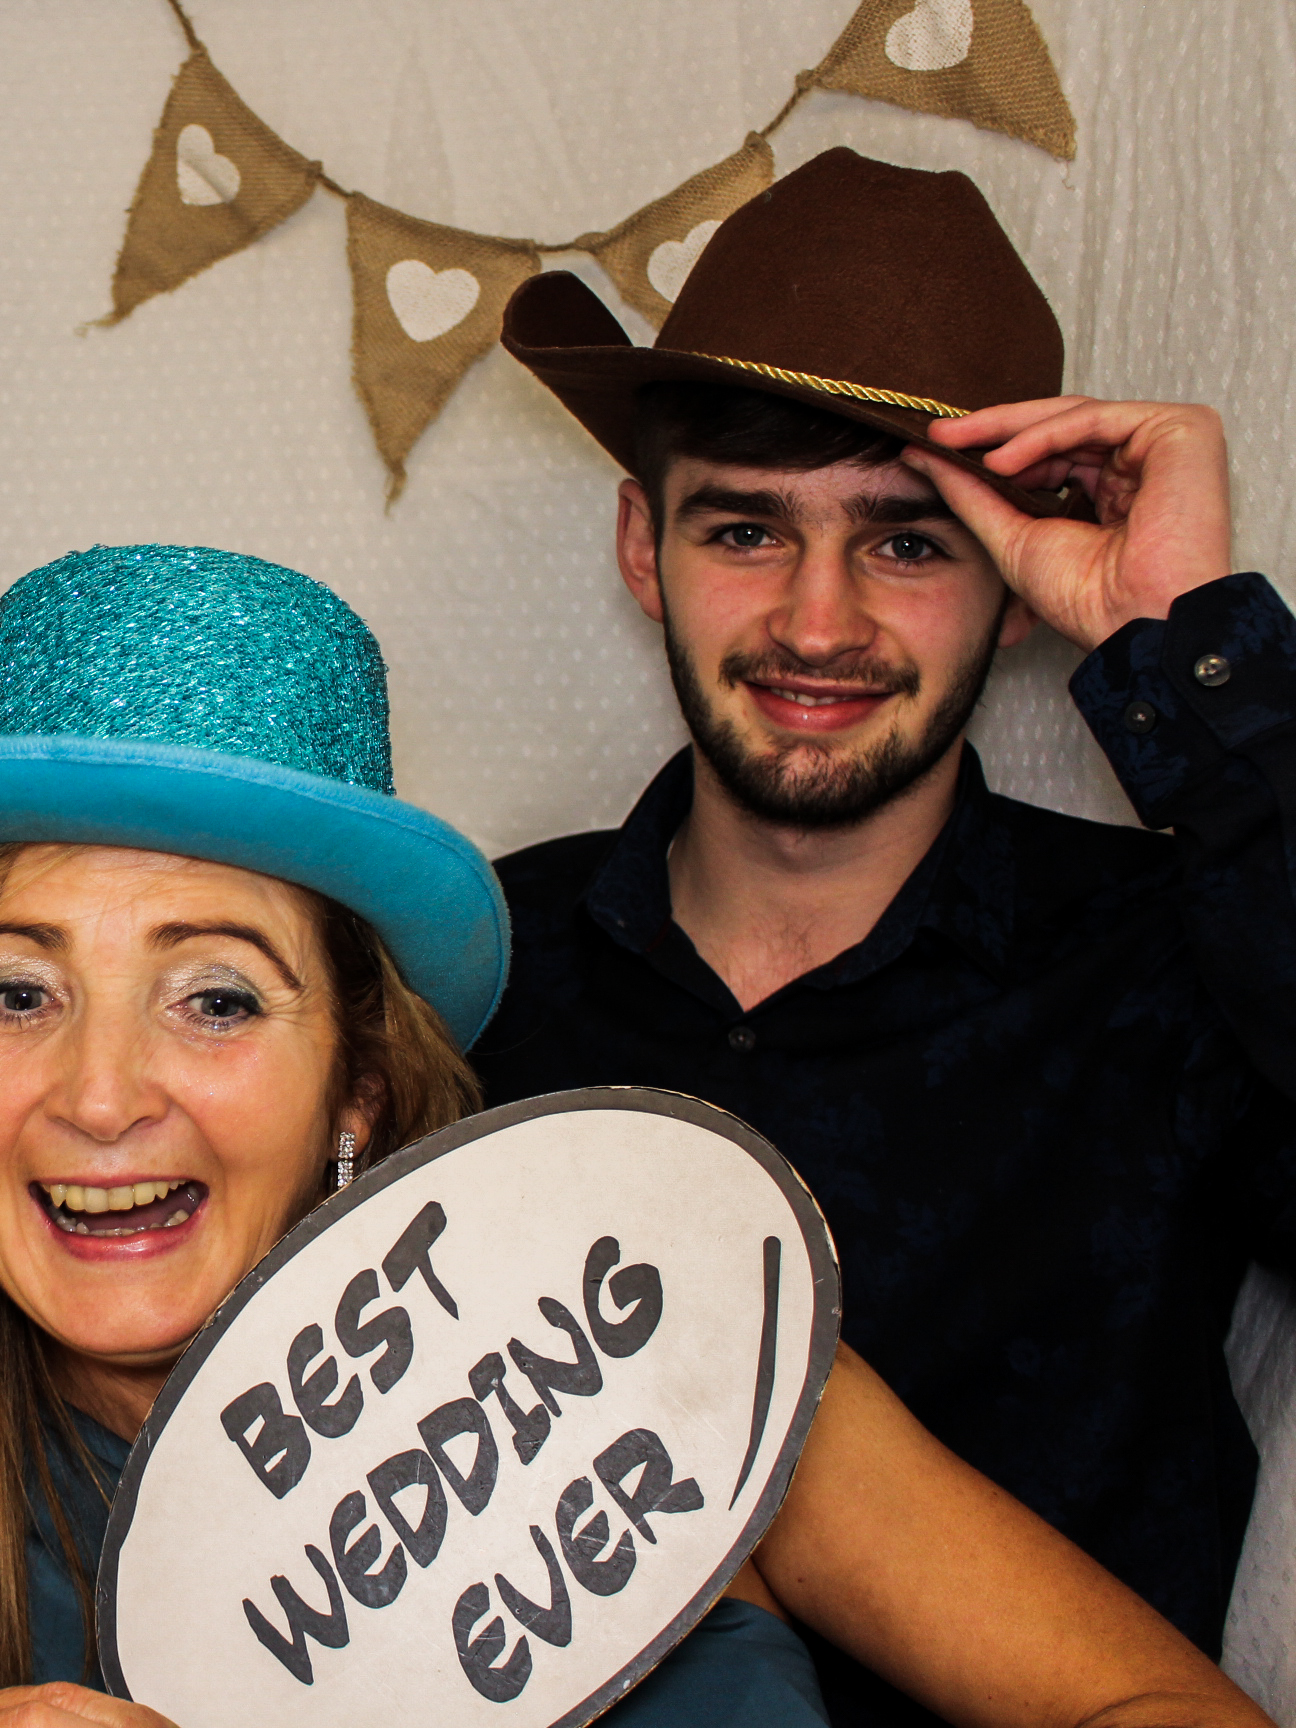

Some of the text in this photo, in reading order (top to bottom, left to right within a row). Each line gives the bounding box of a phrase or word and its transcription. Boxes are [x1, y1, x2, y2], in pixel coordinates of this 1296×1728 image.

[220, 1201, 459, 1499] BEST
[242, 1236, 663, 1686] WEDDING
[452, 1428, 704, 1703] EVER
